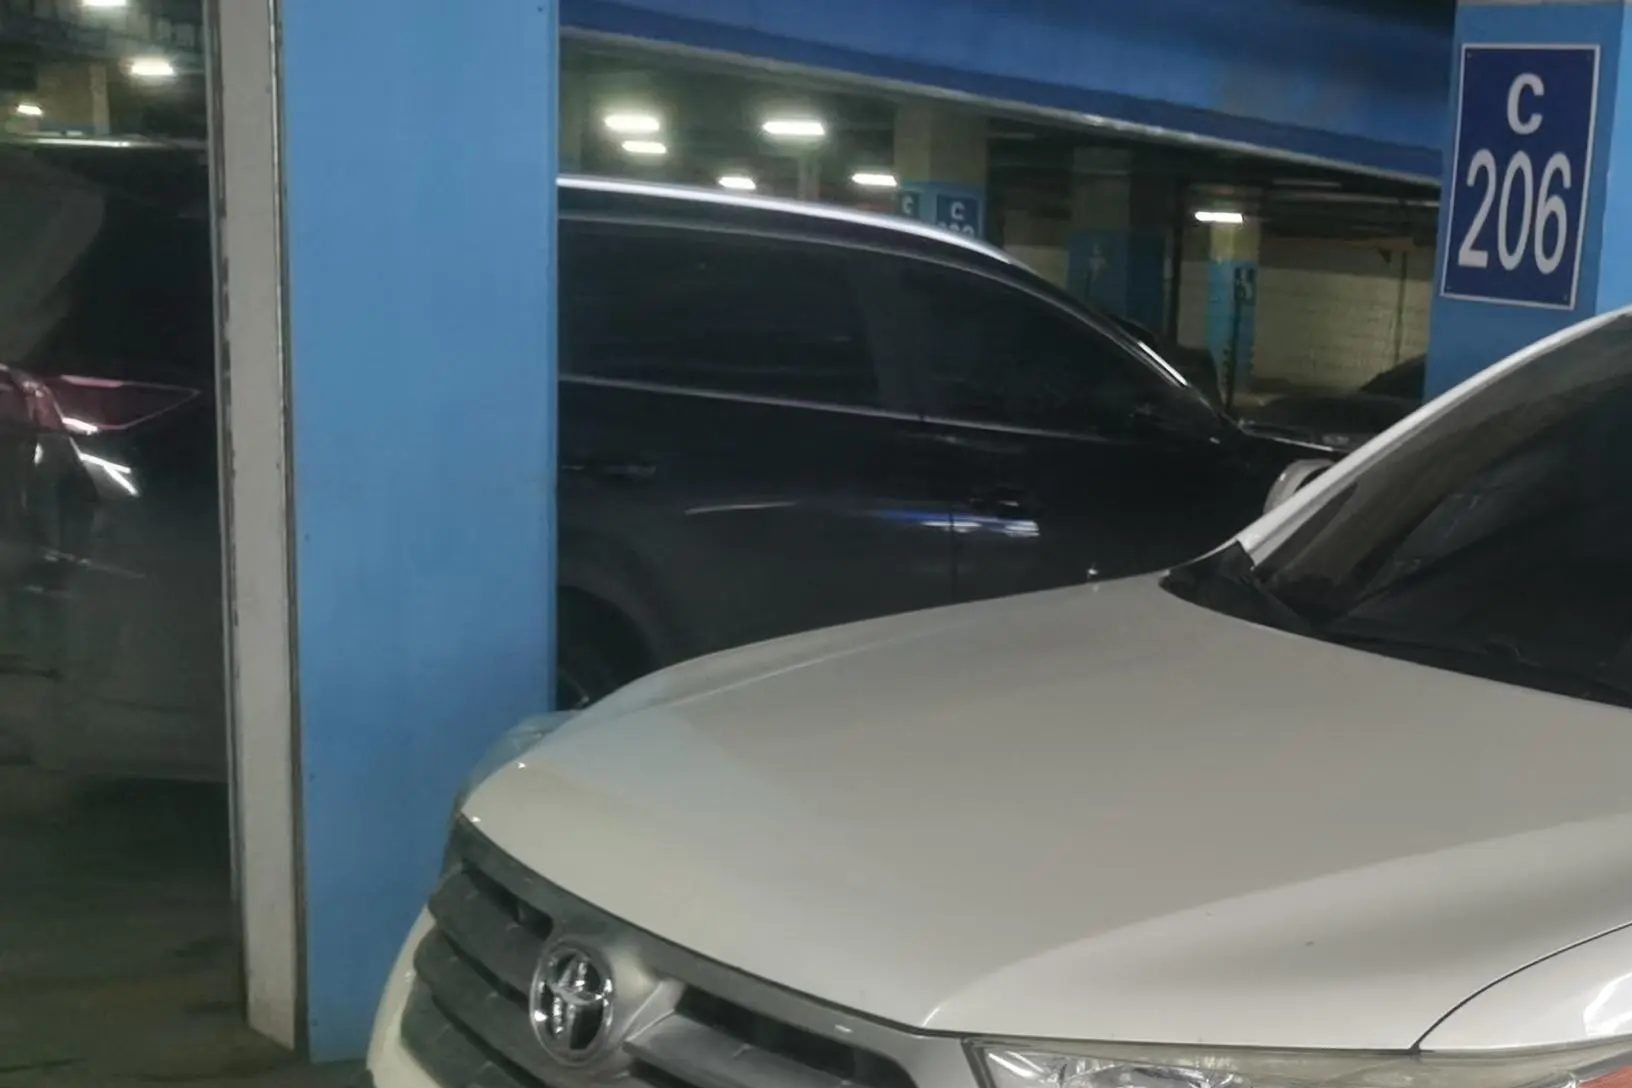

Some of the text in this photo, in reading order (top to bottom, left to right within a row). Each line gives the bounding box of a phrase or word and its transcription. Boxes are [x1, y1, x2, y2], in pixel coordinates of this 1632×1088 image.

[1507, 73, 1545, 135] C
[951, 201, 965, 220] C
[1458, 149, 1572, 274] 206
